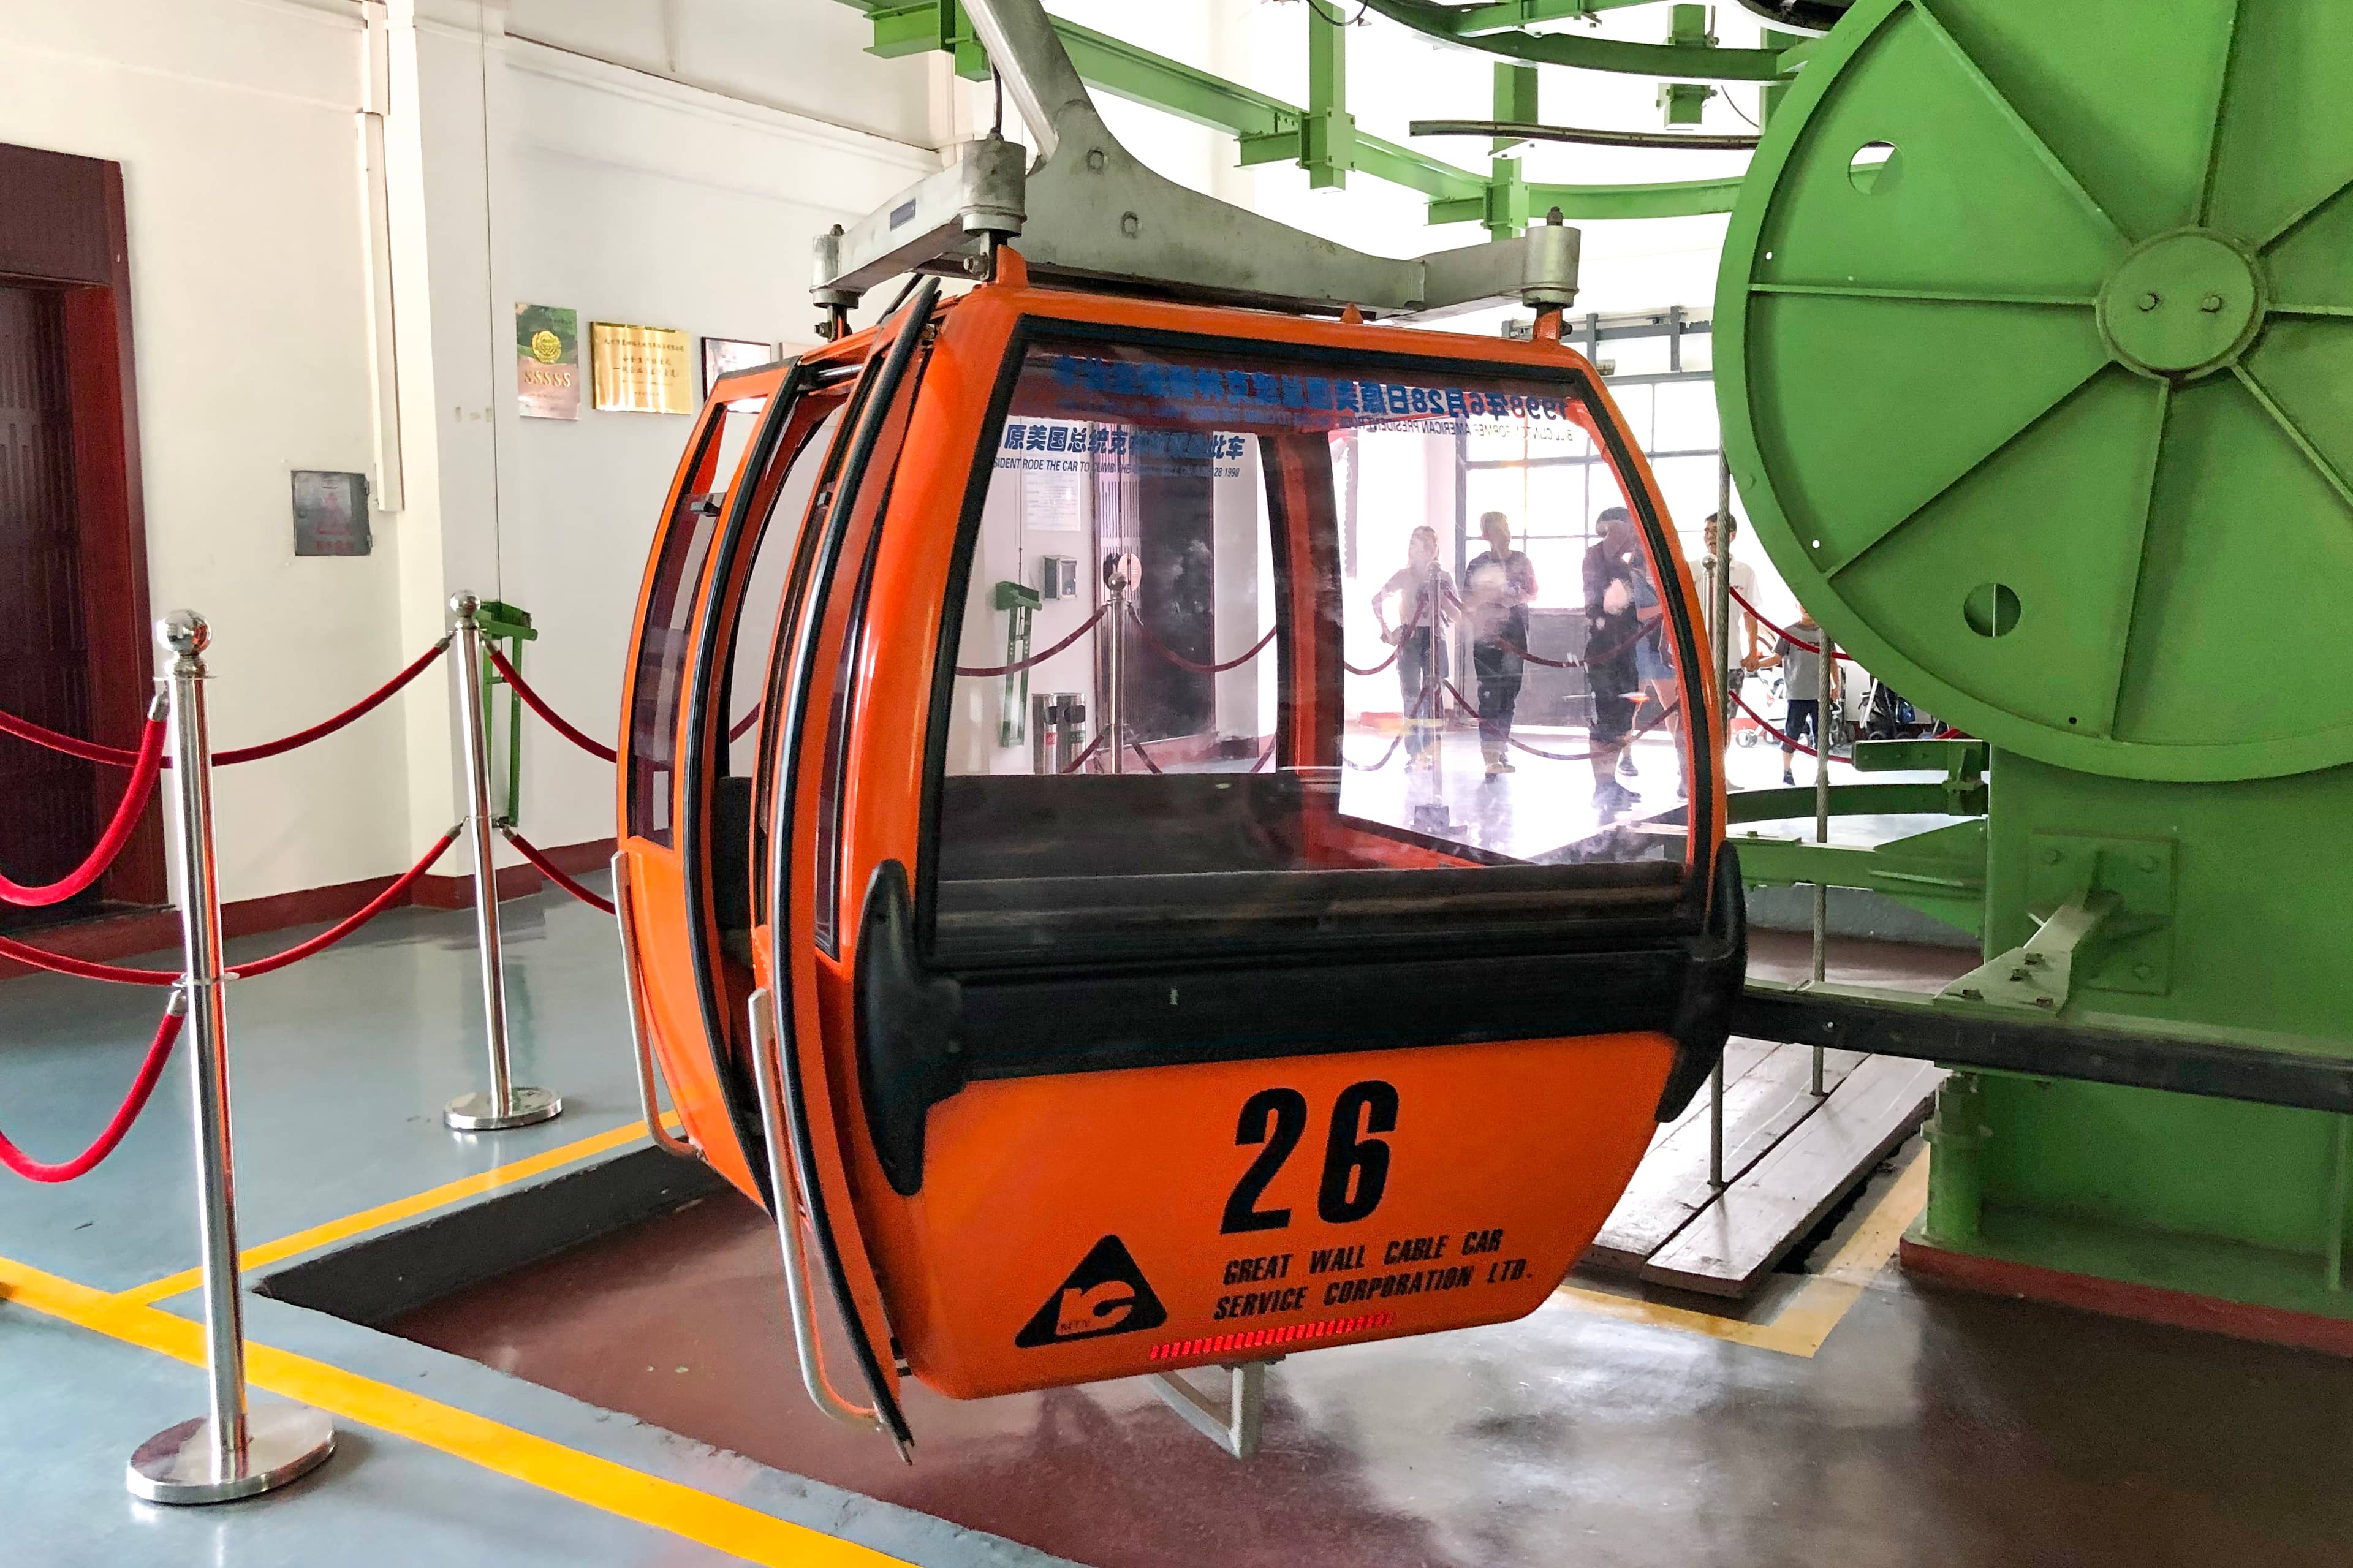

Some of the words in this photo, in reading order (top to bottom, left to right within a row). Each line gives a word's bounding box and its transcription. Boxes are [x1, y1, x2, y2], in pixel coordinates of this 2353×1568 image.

[1023, 458, 1044, 471] RODE
[1047, 460, 1060, 471] THE
[1063, 461, 1078, 472] CAR
[1080, 461, 1089, 472] TO
[1214, 467, 1223, 477] 28
[1221, 1080, 1400, 1235] 26
[1223, 1253, 1294, 1285] GREAT
[1309, 1245, 1365, 1274] WALL
[1384, 1234, 1450, 1265] CABLE
[1461, 1229, 1504, 1256] CAR
[1214, 1286, 1308, 1320] SERVICE
[1323, 1265, 1474, 1306] CORPORATION
[1487, 1258, 1532, 1284] LTD.
